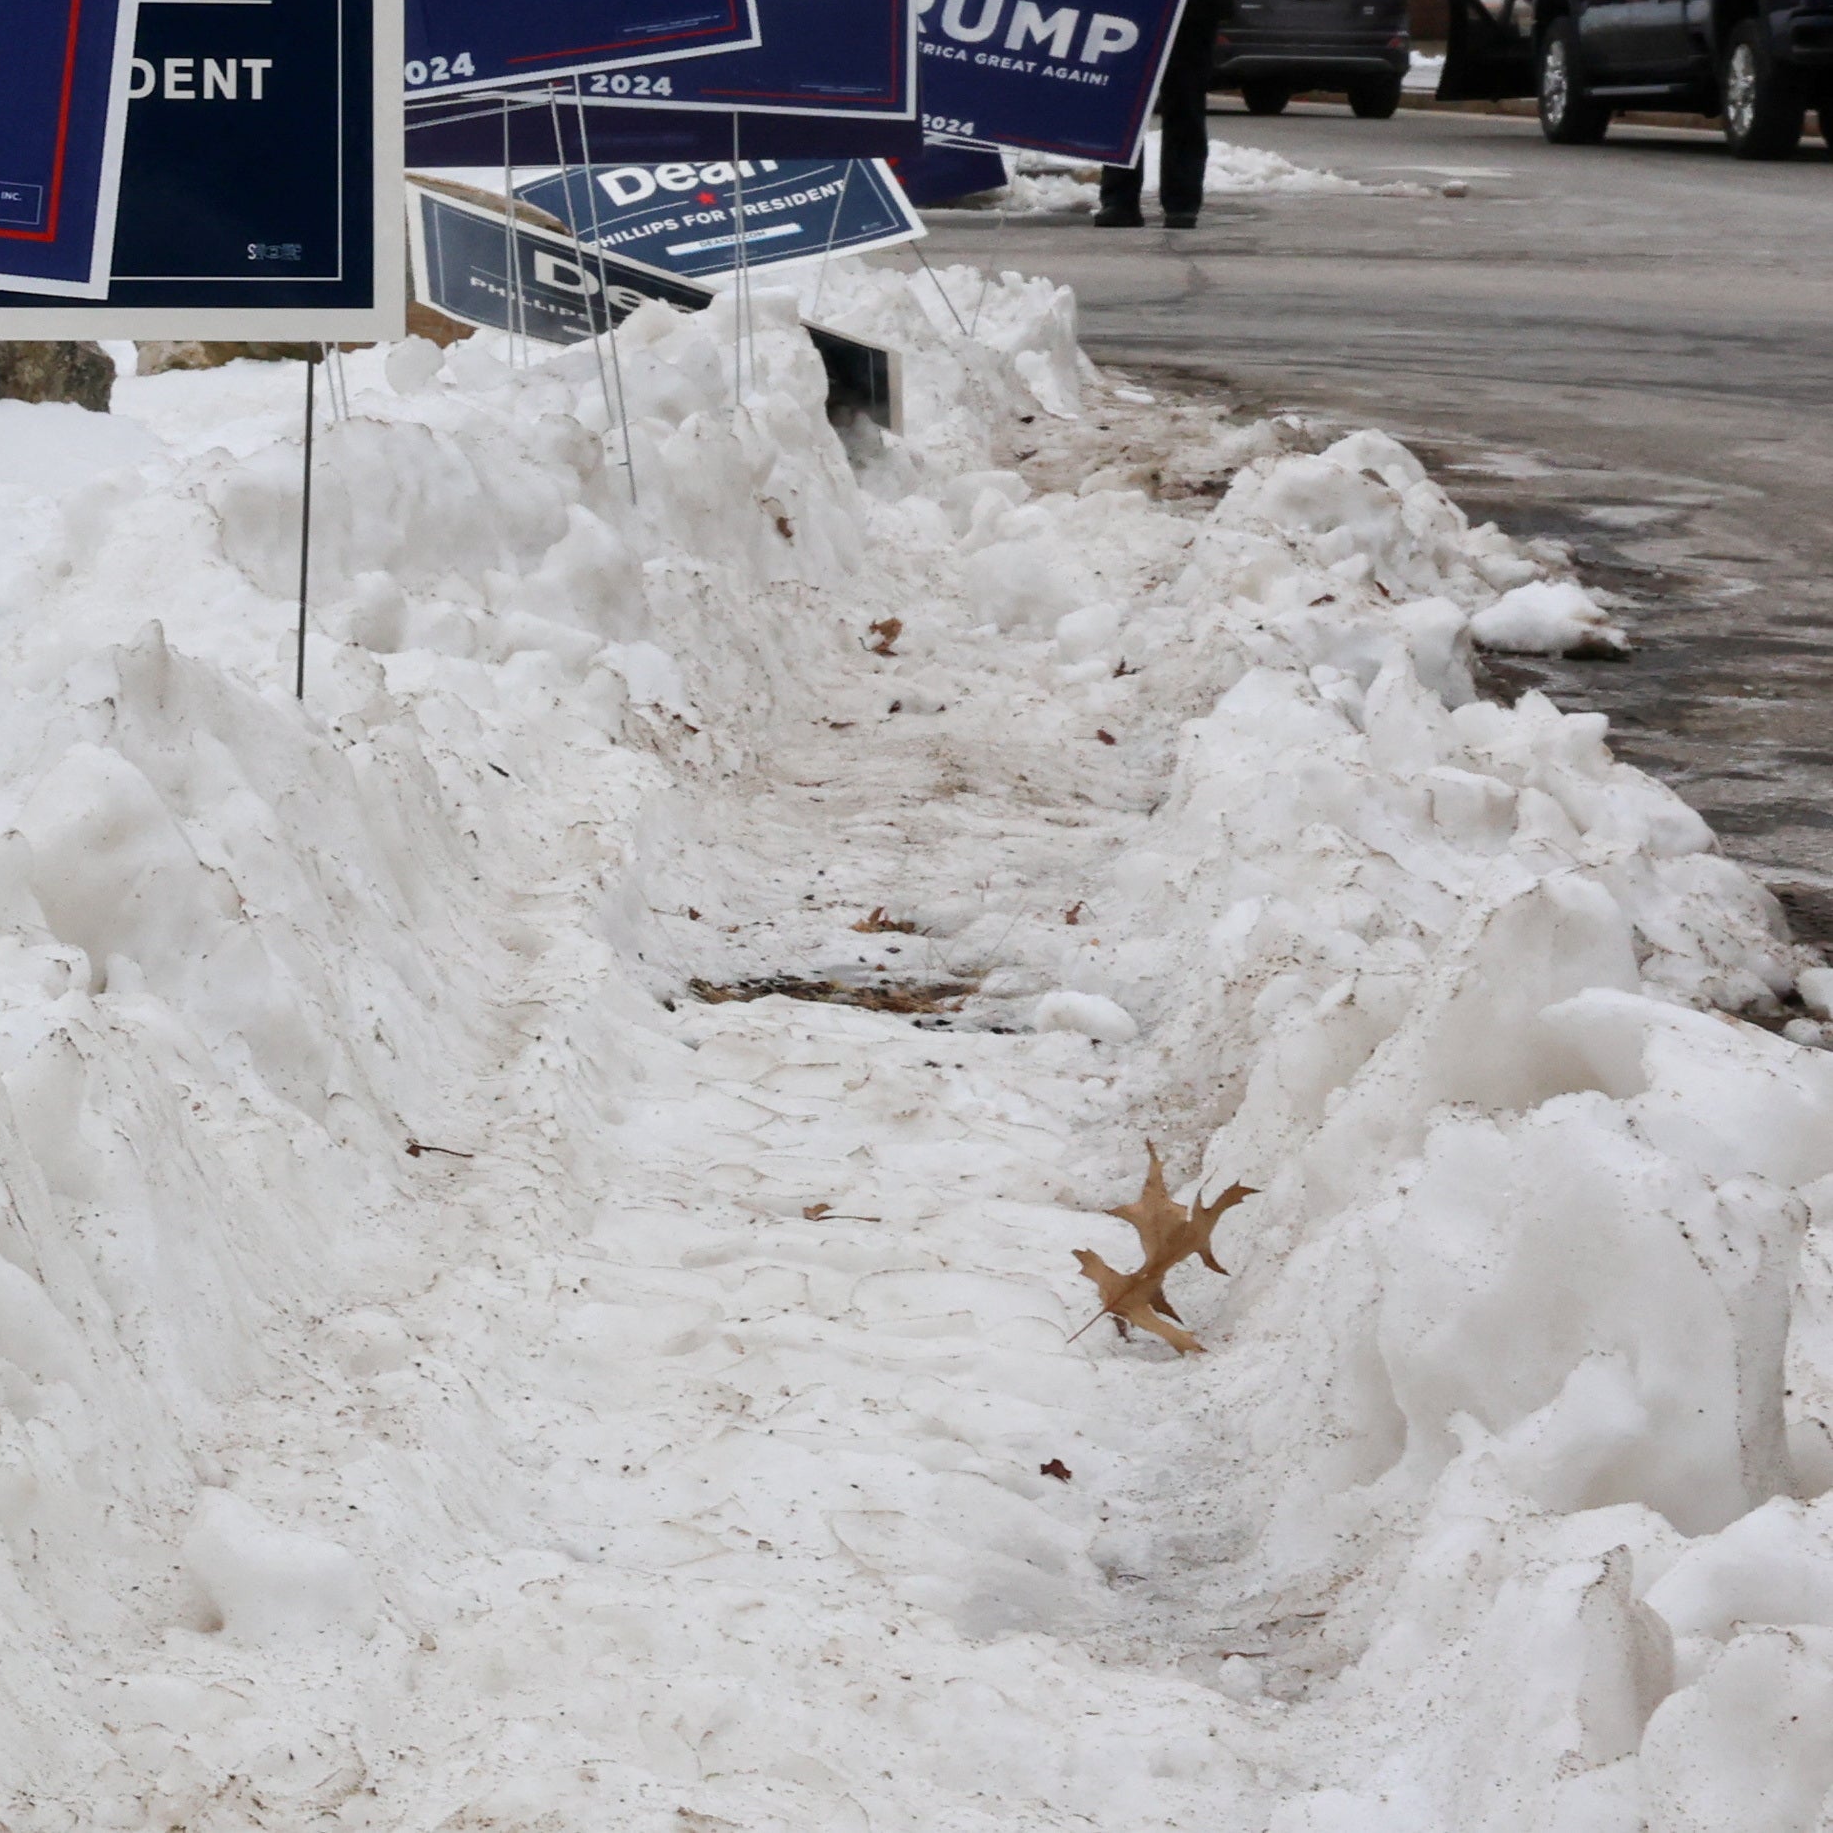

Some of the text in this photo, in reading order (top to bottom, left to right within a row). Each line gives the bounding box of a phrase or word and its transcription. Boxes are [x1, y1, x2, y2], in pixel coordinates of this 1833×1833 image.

[128, 57, 273, 101] DENT
[974, 52, 1037, 73] GREAT
[1041, 65, 1110, 86] AGAIN!
[589, 73, 673, 96] 2024
[1, 191, 22, 201] INC.
[682, 209, 727, 227] FOR
